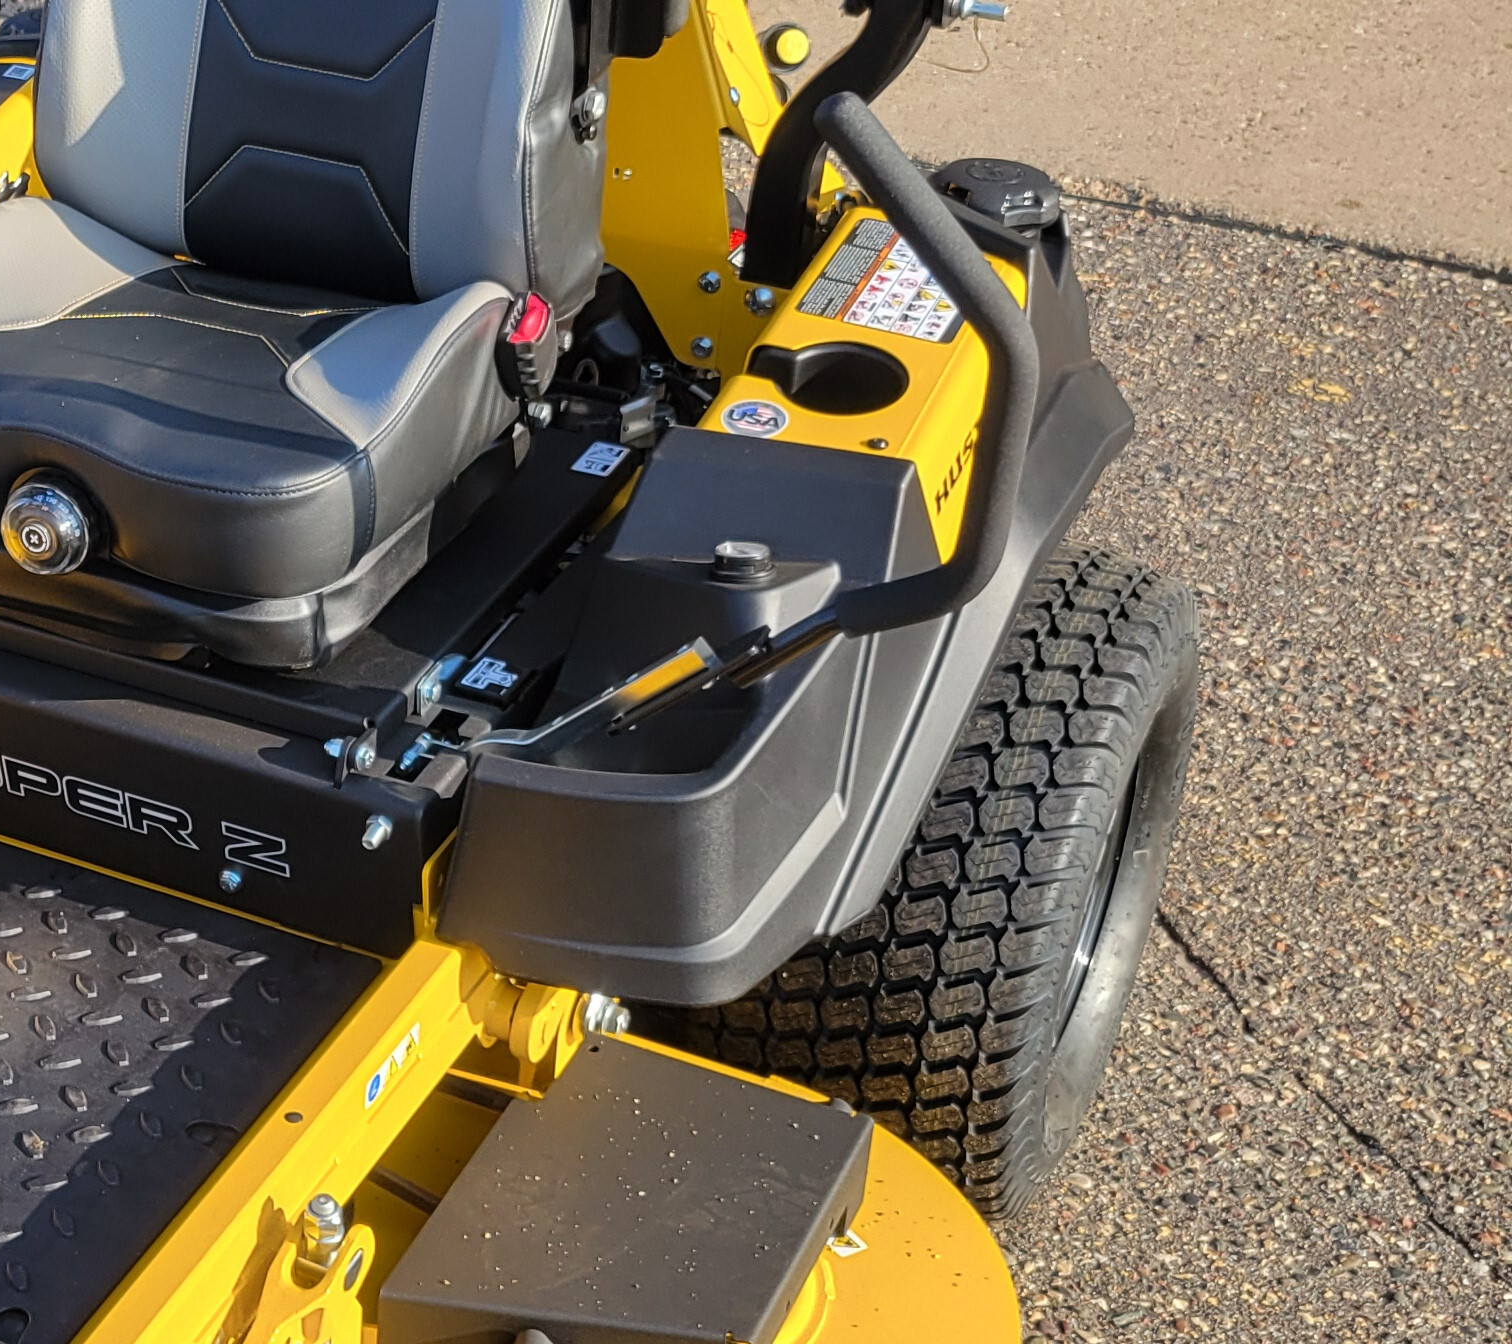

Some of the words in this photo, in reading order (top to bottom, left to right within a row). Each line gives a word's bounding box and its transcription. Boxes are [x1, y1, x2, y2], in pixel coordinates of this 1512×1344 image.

[727, 409, 781, 429] USA
[934, 429, 974, 515] HUS
[221, 820, 291, 878] Z
